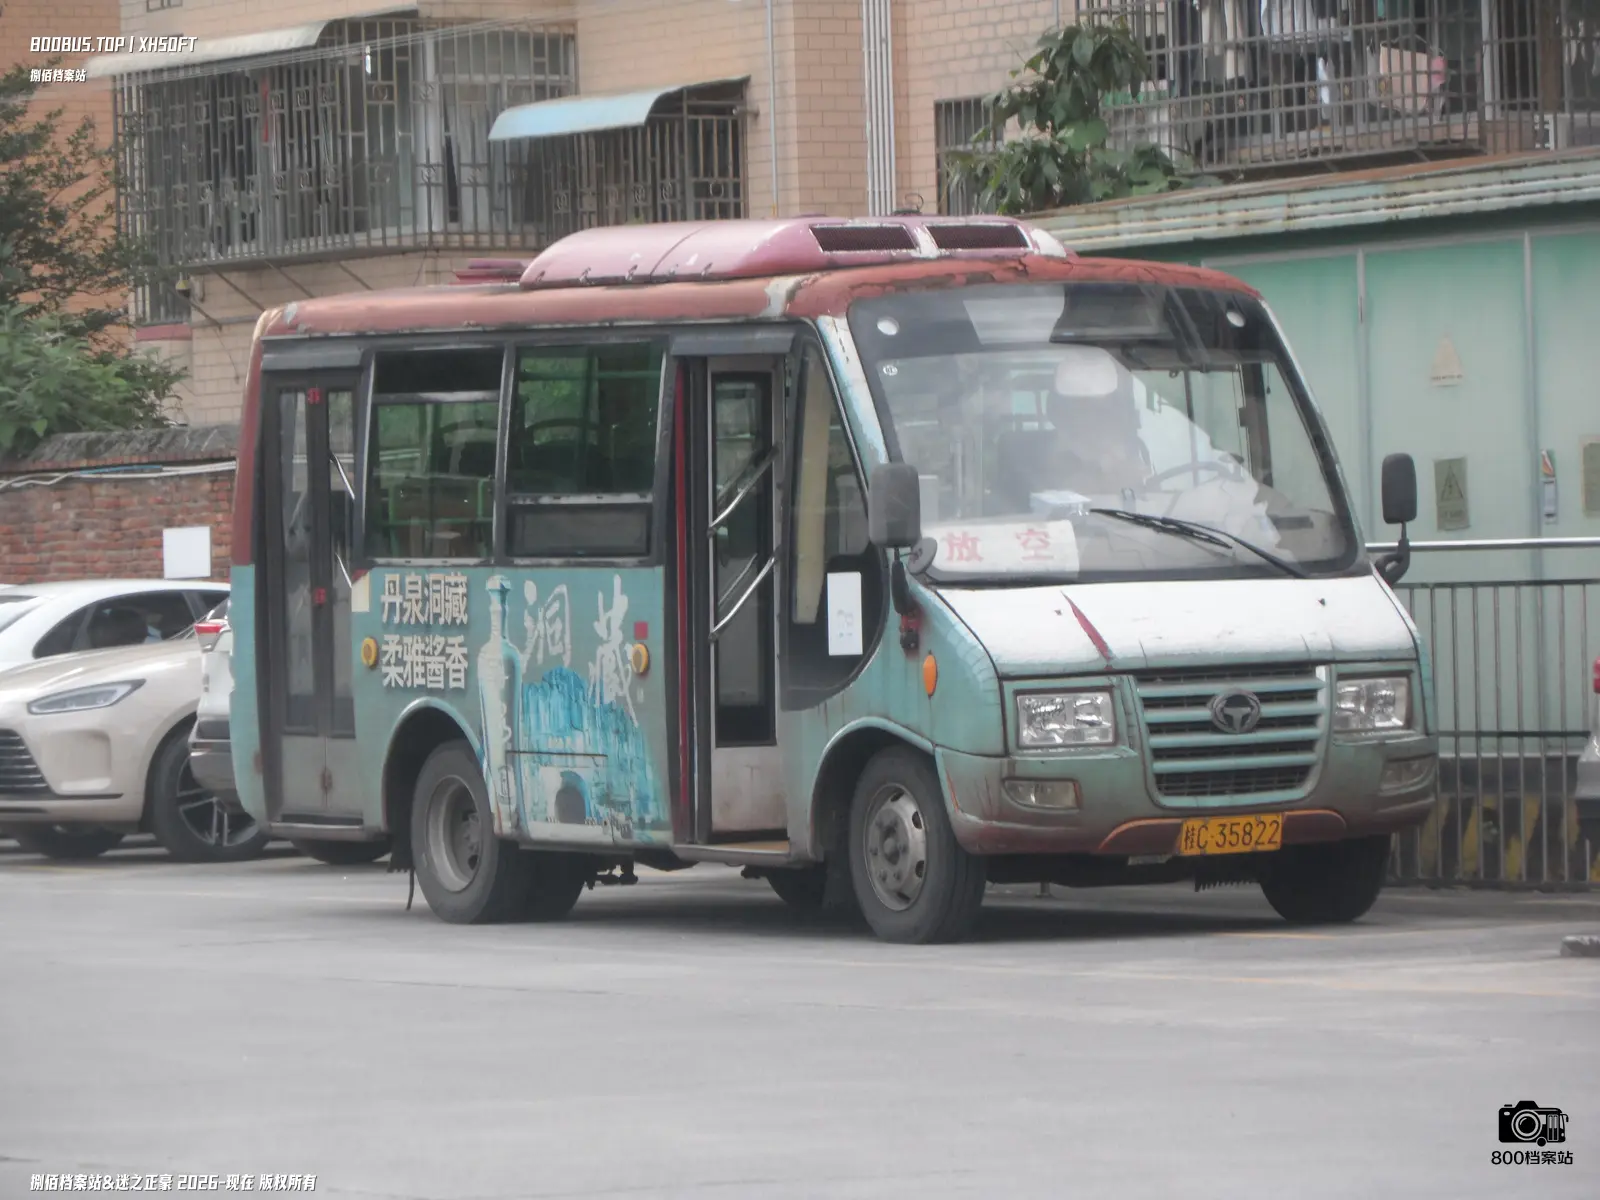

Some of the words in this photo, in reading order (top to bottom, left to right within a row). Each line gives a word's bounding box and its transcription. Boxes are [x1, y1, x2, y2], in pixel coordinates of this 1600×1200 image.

[944, 528, 1054, 563] 放空
[381, 572, 468, 625] 丹泉洞藏
[381, 634, 468, 689] 柔雅酱香
